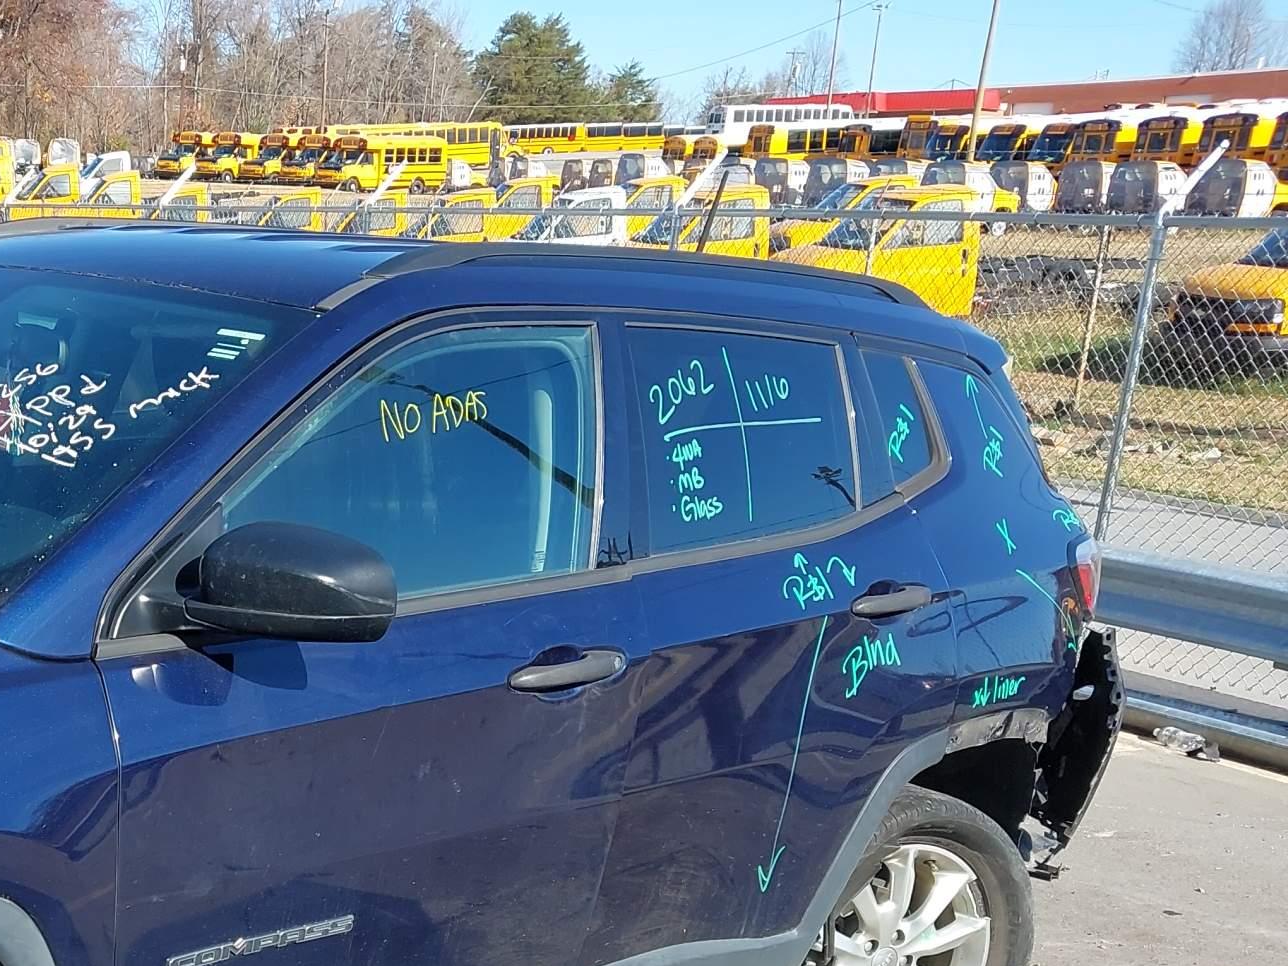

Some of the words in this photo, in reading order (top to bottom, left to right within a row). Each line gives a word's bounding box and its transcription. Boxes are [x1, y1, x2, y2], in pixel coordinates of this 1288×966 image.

[380, 399, 421, 443] NO
[432, 390, 488, 434] ADAS
[649, 359, 715, 425] 2062
[681, 495, 724, 522] Glass
[842, 632, 902, 700] Blnd
